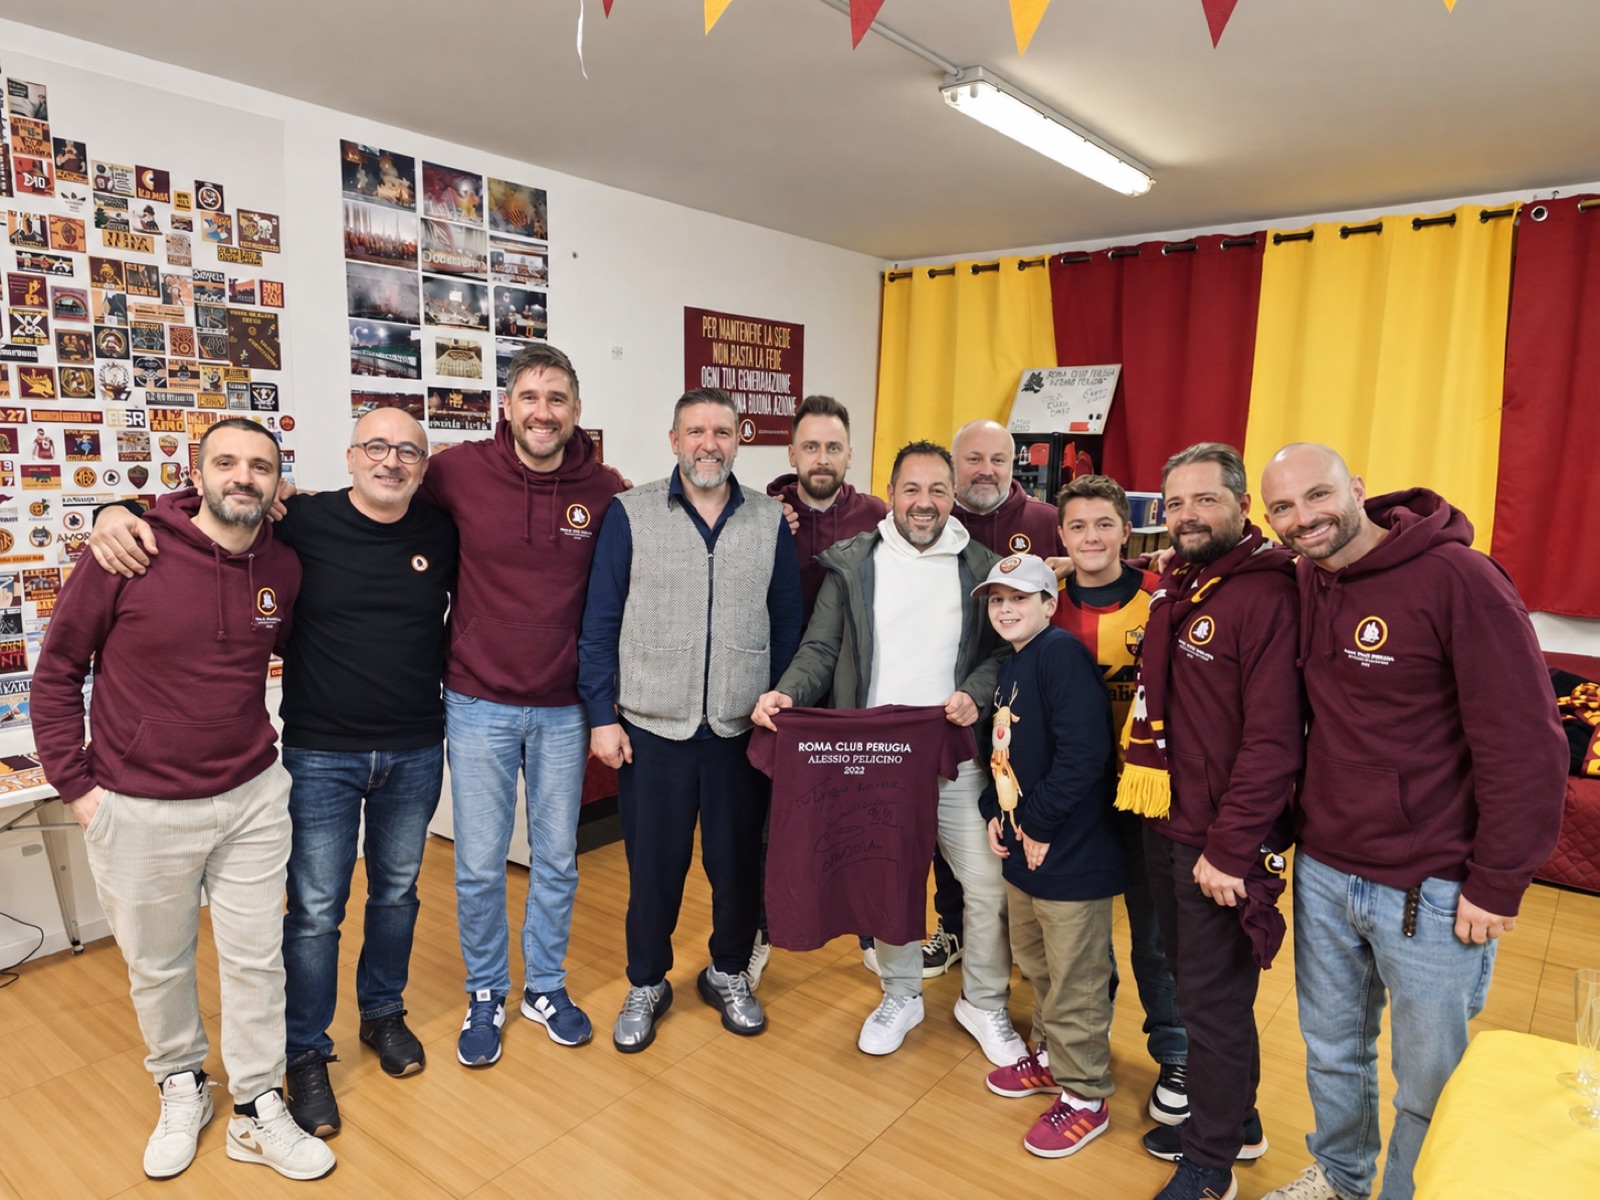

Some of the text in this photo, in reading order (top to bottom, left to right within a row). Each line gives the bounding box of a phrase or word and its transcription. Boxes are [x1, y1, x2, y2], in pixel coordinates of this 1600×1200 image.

[702, 315, 717, 339] PER
[764, 325, 773, 347] LA
[712, 342, 782, 371] NON BASTA LA FEDE
[701, 366, 719, 389] OGNI
[721, 367, 737, 390] TUA
[798, 741, 912, 753] ROMA CLUB PERUGIA
[808, 754, 850, 764] ALESSIO
[843, 766, 865, 775] 2022
